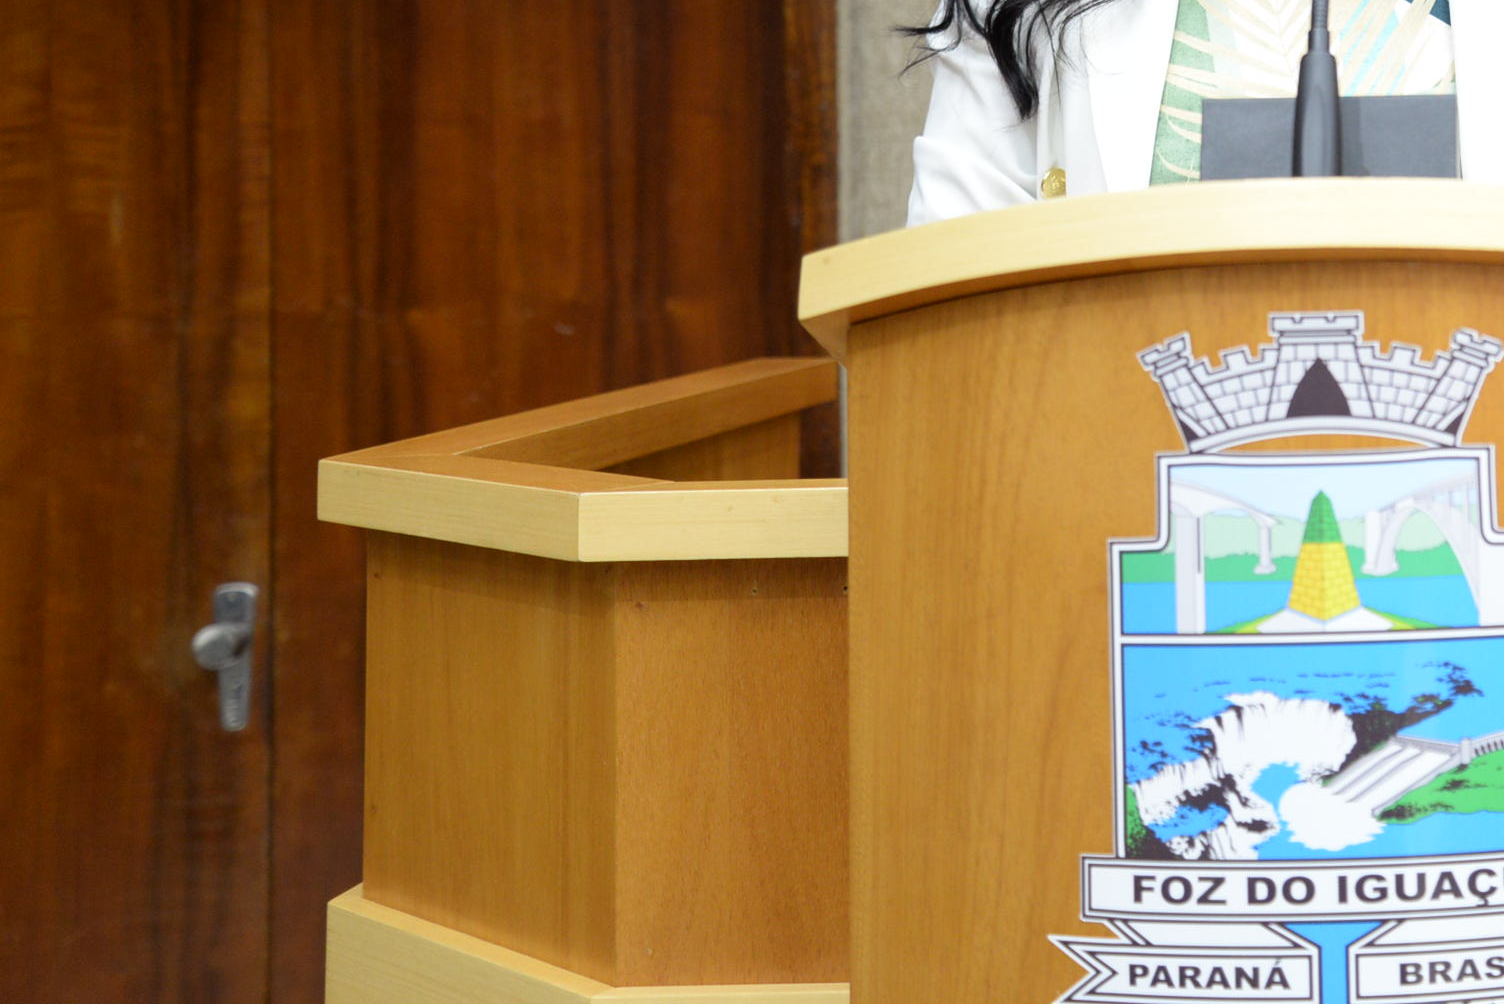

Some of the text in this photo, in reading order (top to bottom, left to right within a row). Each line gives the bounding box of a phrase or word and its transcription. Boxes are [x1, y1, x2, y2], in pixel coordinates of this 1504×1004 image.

[1132, 875, 1228, 905] FOZ
[1246, 876, 1316, 905] DO
[1128, 959, 1291, 990] PARANÁ
